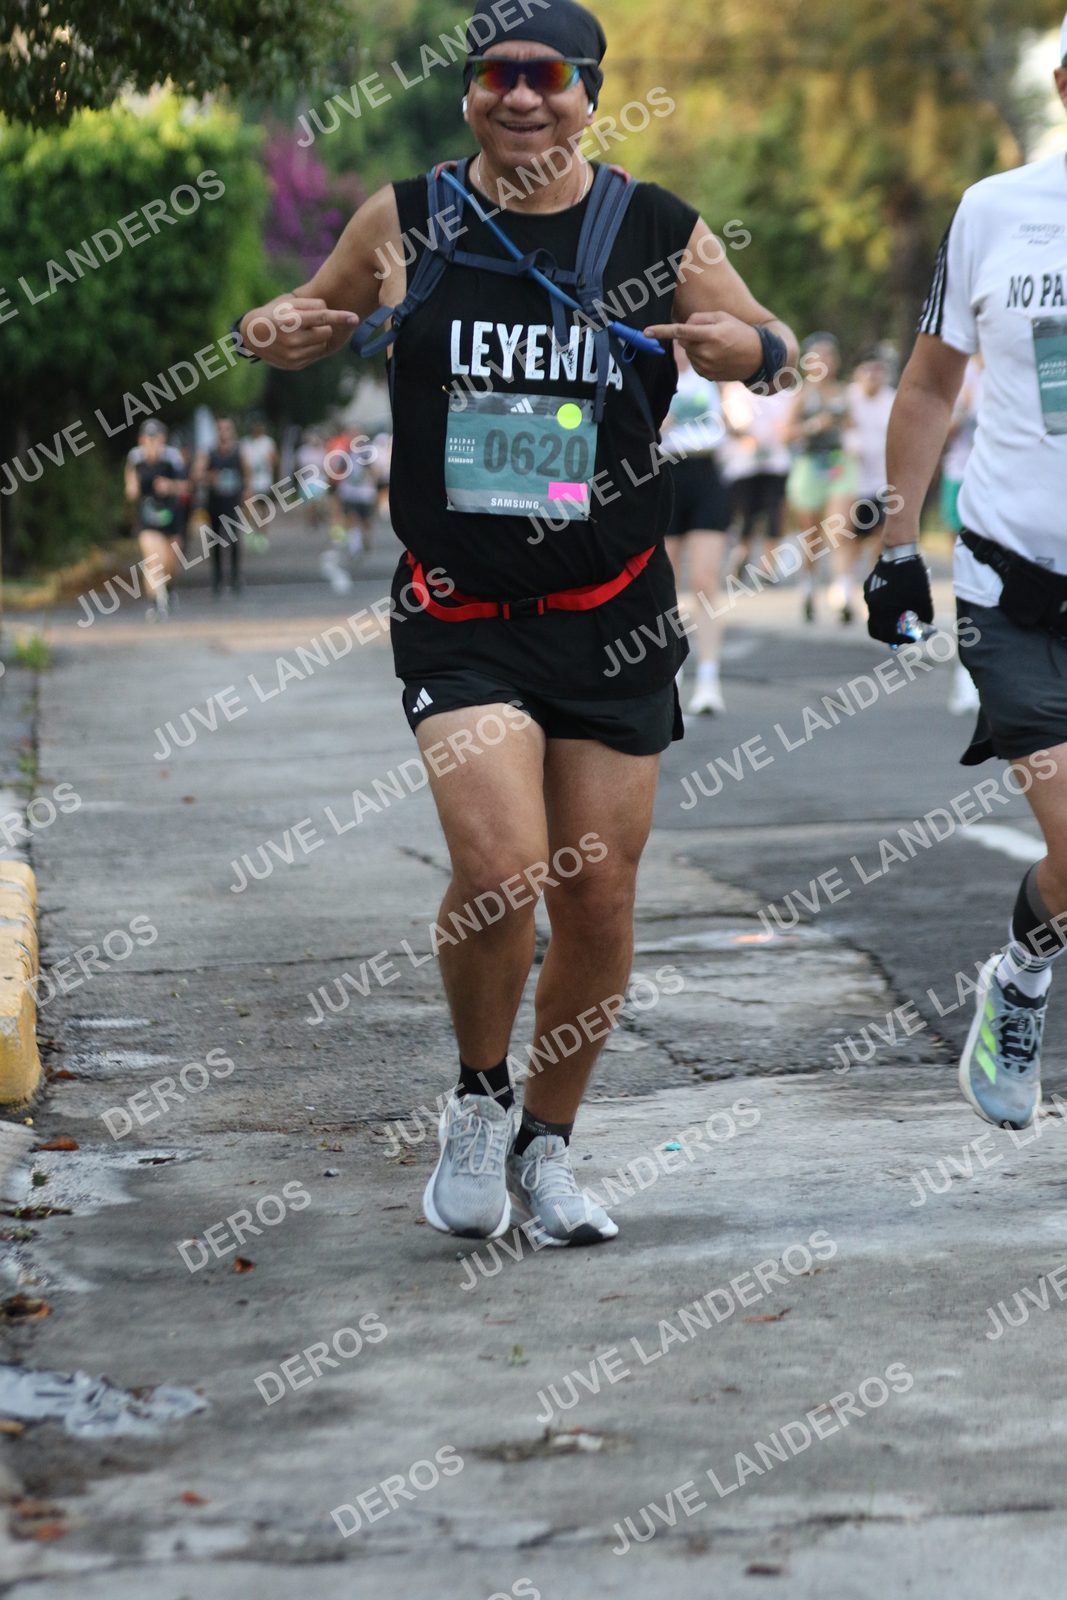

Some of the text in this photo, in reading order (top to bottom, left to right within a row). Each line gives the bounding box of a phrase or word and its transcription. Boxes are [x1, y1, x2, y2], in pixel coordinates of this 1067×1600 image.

[1007, 274, 1034, 308] NO
[483, 429, 589, 481] 0620
[491, 497, 540, 510] SAMSUNG
